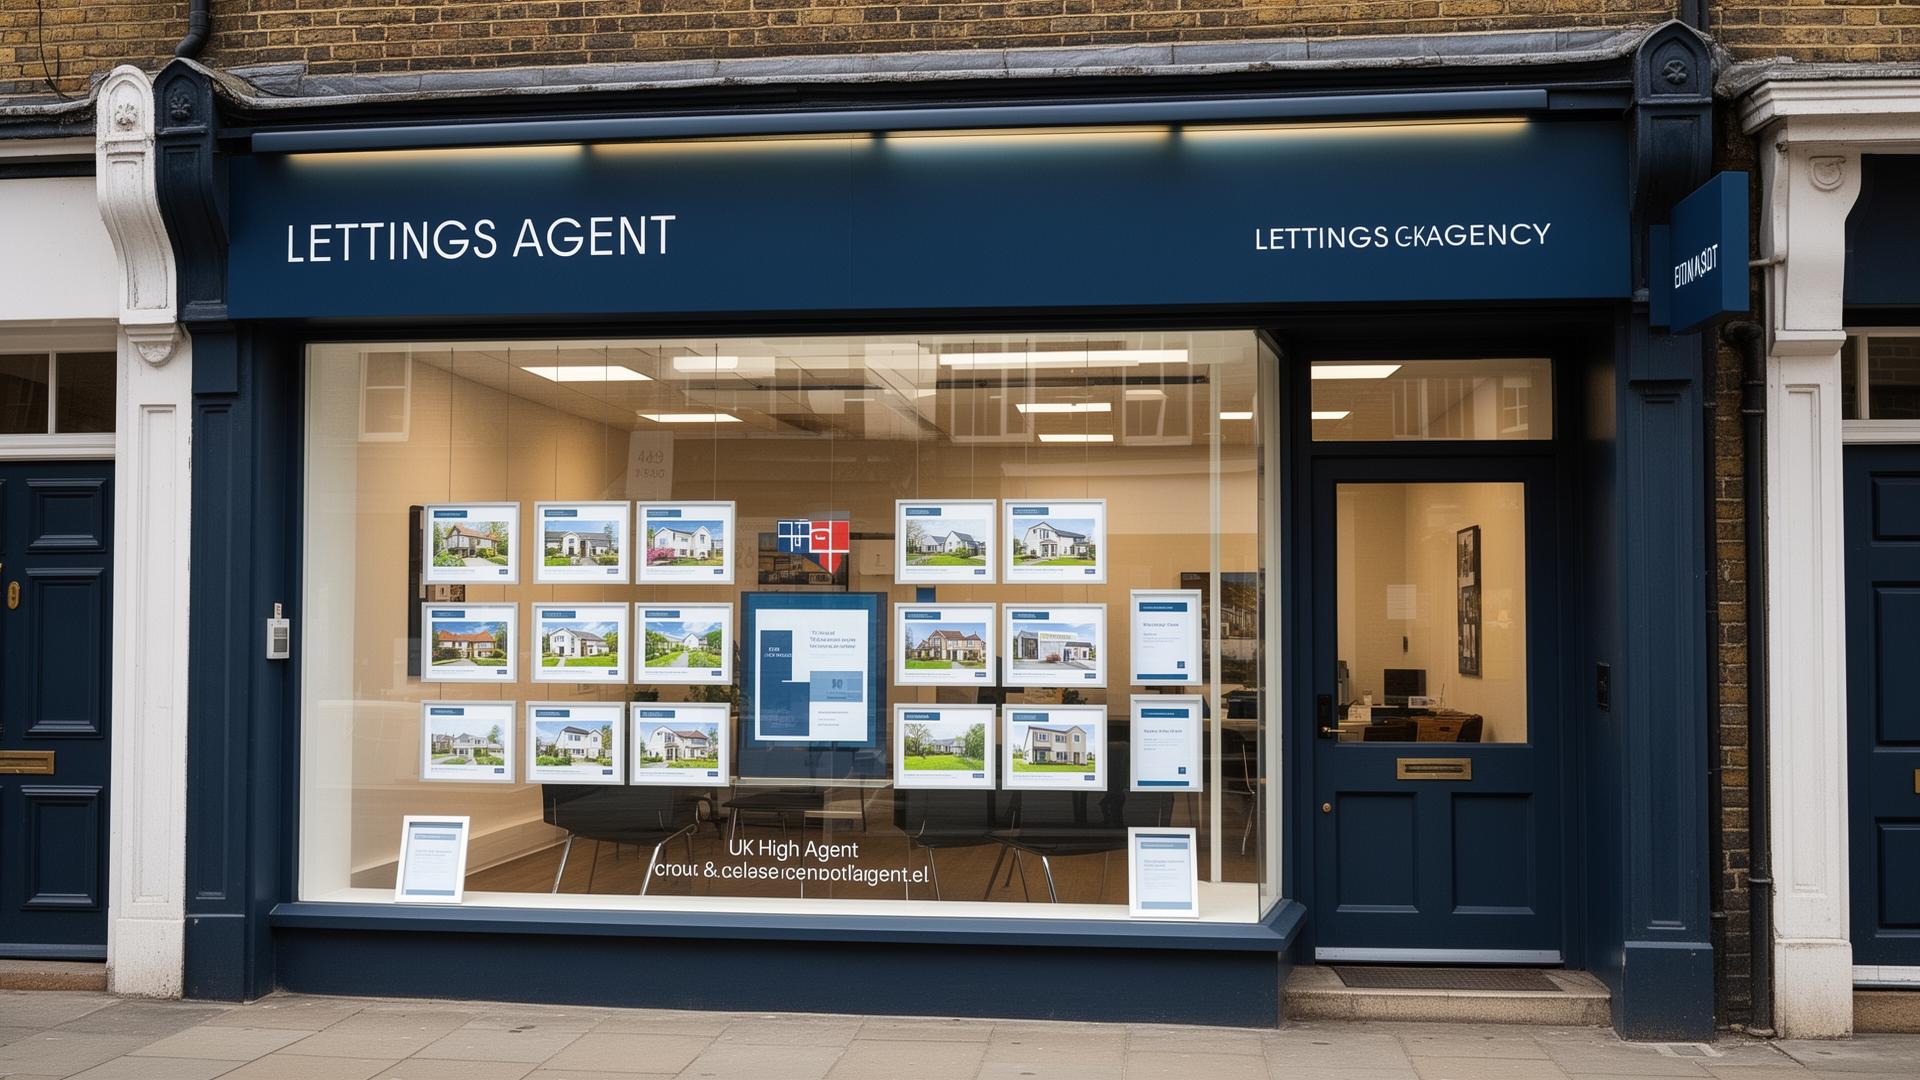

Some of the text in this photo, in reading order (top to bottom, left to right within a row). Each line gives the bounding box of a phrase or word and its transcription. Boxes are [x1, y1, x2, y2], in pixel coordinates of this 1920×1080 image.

[287, 214, 676, 264] LETTINGS AGENT
[1255, 225, 1389, 250] LETTINGS
[729, 839, 859, 863] UK High Agent
